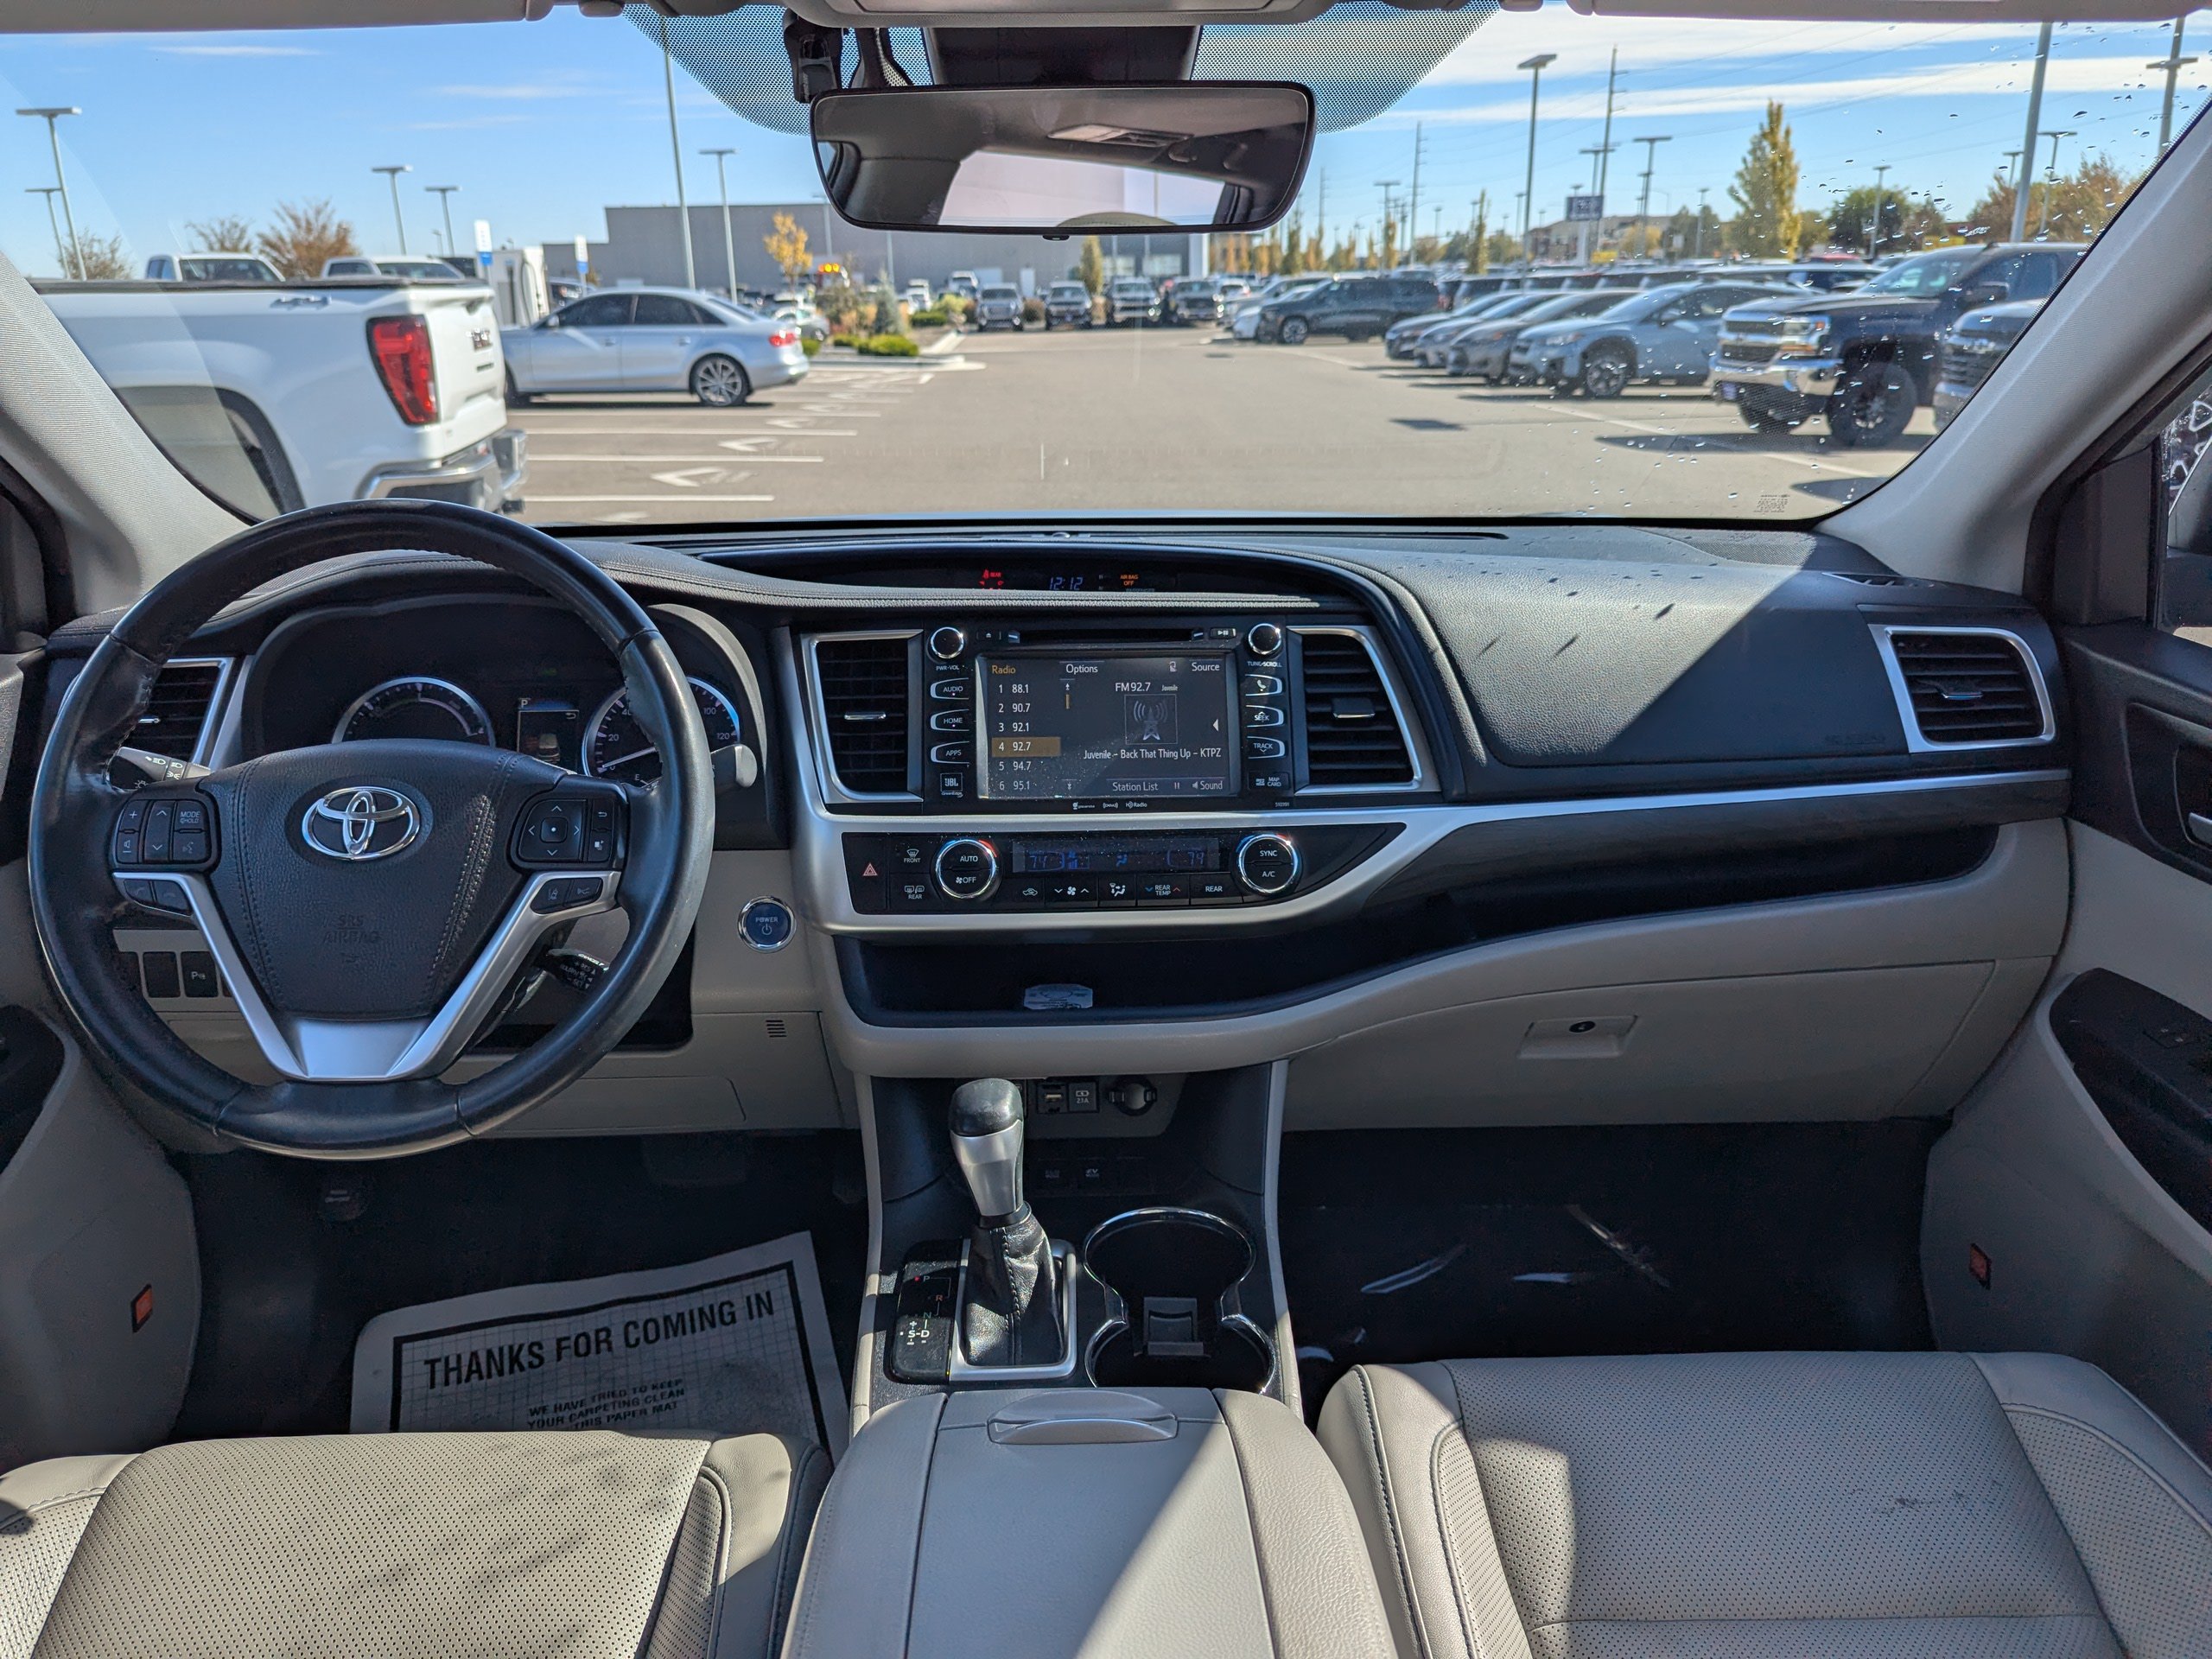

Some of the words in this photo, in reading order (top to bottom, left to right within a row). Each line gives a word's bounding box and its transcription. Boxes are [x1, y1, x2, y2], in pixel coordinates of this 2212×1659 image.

[1049, 577, 1084, 590] 12:12
[992, 665, 1016, 674] Radio
[1065, 664, 1098, 675] Options
[1192, 662, 1220, 671] Source
[999, 684, 1003, 693] 1
[1012, 684, 1029, 693] 88.1
[520, 699, 529, 708] P
[998, 703, 1004, 713] 2
[1012, 703, 1031, 713] 90.7
[998, 722, 1004, 732] 3
[1013, 722, 1030, 732] 92.1
[999, 742, 1005, 751] 4
[1013, 741, 1032, 751] 92.7
[1084, 749, 1111, 760] Juvenile
[1120, 749, 1138, 759] Back
[1140, 748, 1156, 759] That
[1158, 748, 1179, 760] Thing
[1180, 748, 1192, 760] Up
[1200, 747, 1222, 758] KTPZ
[999, 761, 1005, 771] 5
[1013, 761, 1032, 771] 94.7
[944, 778, 959, 787] JBL
[999, 781, 1005, 790] 6
[1013, 780, 1030, 791] 95.1
[1112, 781, 1141, 791] Station
[1142, 781, 1160, 791] List
[1199, 780, 1224, 790] Sound
[423, 1340, 546, 1390] THANKS
[556, 1326, 613, 1363] FOR
[623, 1300, 738, 1349] COMING
[747, 1290, 775, 1321] IN
[529, 1404, 549, 1417] WE
[554, 1398, 587, 1413] HAVE
[591, 1389, 627, 1403] TRIED
[632, 1384, 648, 1394] TO
[526, 1415, 564, 1430] YOUR
[569, 1397, 641, 1423] CARPETING
[644, 1388, 685, 1404] CLEAN
[574, 1417, 602, 1430] THIS
[606, 1408, 648, 1423] PAPER
[652, 1401, 678, 1414] MAT
